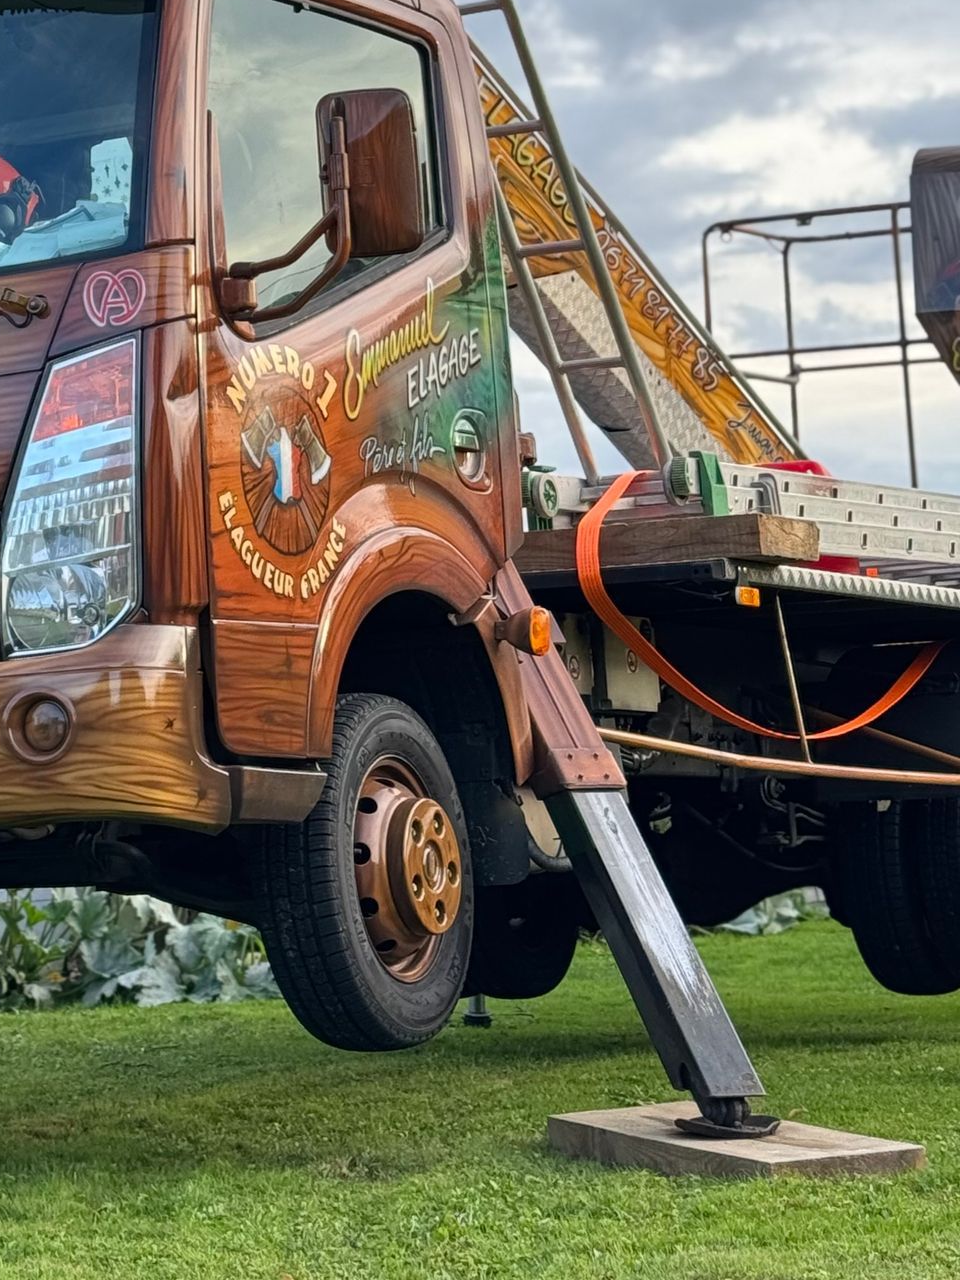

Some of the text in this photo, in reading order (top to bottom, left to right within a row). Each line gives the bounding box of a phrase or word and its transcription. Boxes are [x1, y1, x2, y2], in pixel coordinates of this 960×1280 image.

[226, 343, 338, 419] NUMERO 1
[344, 276, 450, 420] Emmanuel
[407, 327, 482, 410] ELAGAGE
[409, 411, 446, 496] fils
[300, 516, 347, 599] FRANCE
